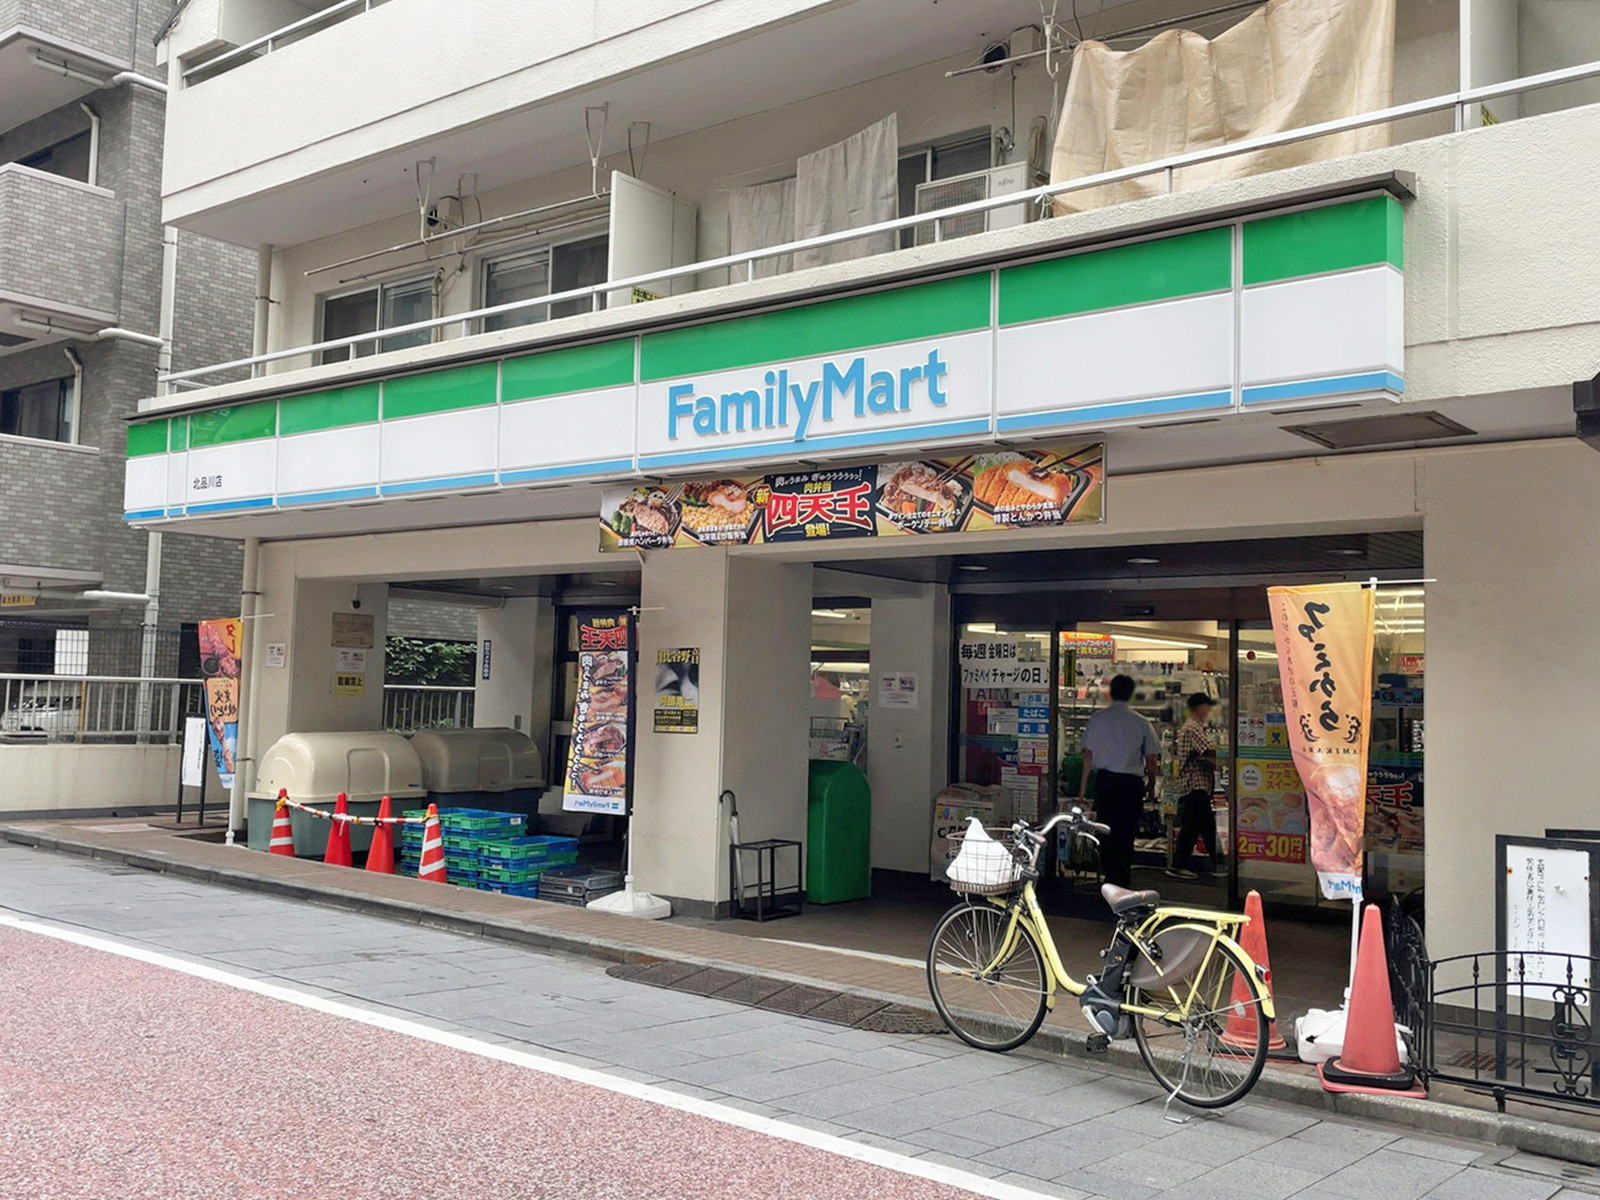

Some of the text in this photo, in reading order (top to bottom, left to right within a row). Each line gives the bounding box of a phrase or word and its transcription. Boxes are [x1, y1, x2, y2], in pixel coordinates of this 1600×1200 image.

[668, 347, 948, 442] FamilyMart
[193, 475, 222, 490] 北品川店
[803, 480, 832, 494] 肉弁当
[756, 488, 770, 504] 新
[765, 481, 874, 537] 四天王
[994, 509, 1063, 524] 特製とんかつ弁当
[1023, 708, 1046, 719] たばこ
